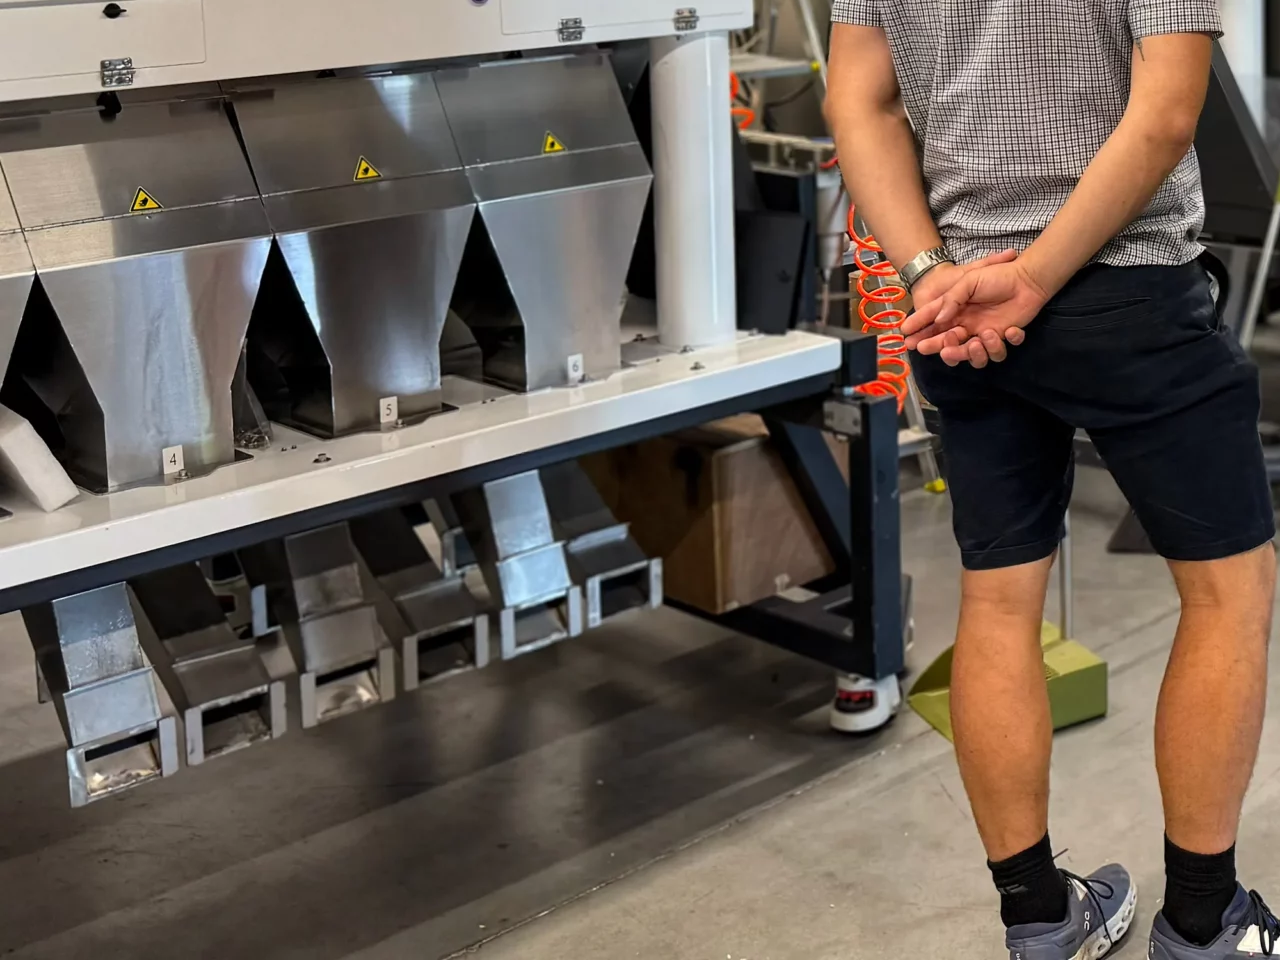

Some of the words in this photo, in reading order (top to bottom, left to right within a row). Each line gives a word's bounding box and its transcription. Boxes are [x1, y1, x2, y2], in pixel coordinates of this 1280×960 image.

[572, 360, 580, 373] 6
[385, 403, 392, 417] 5
[169, 452, 177, 466] 4
